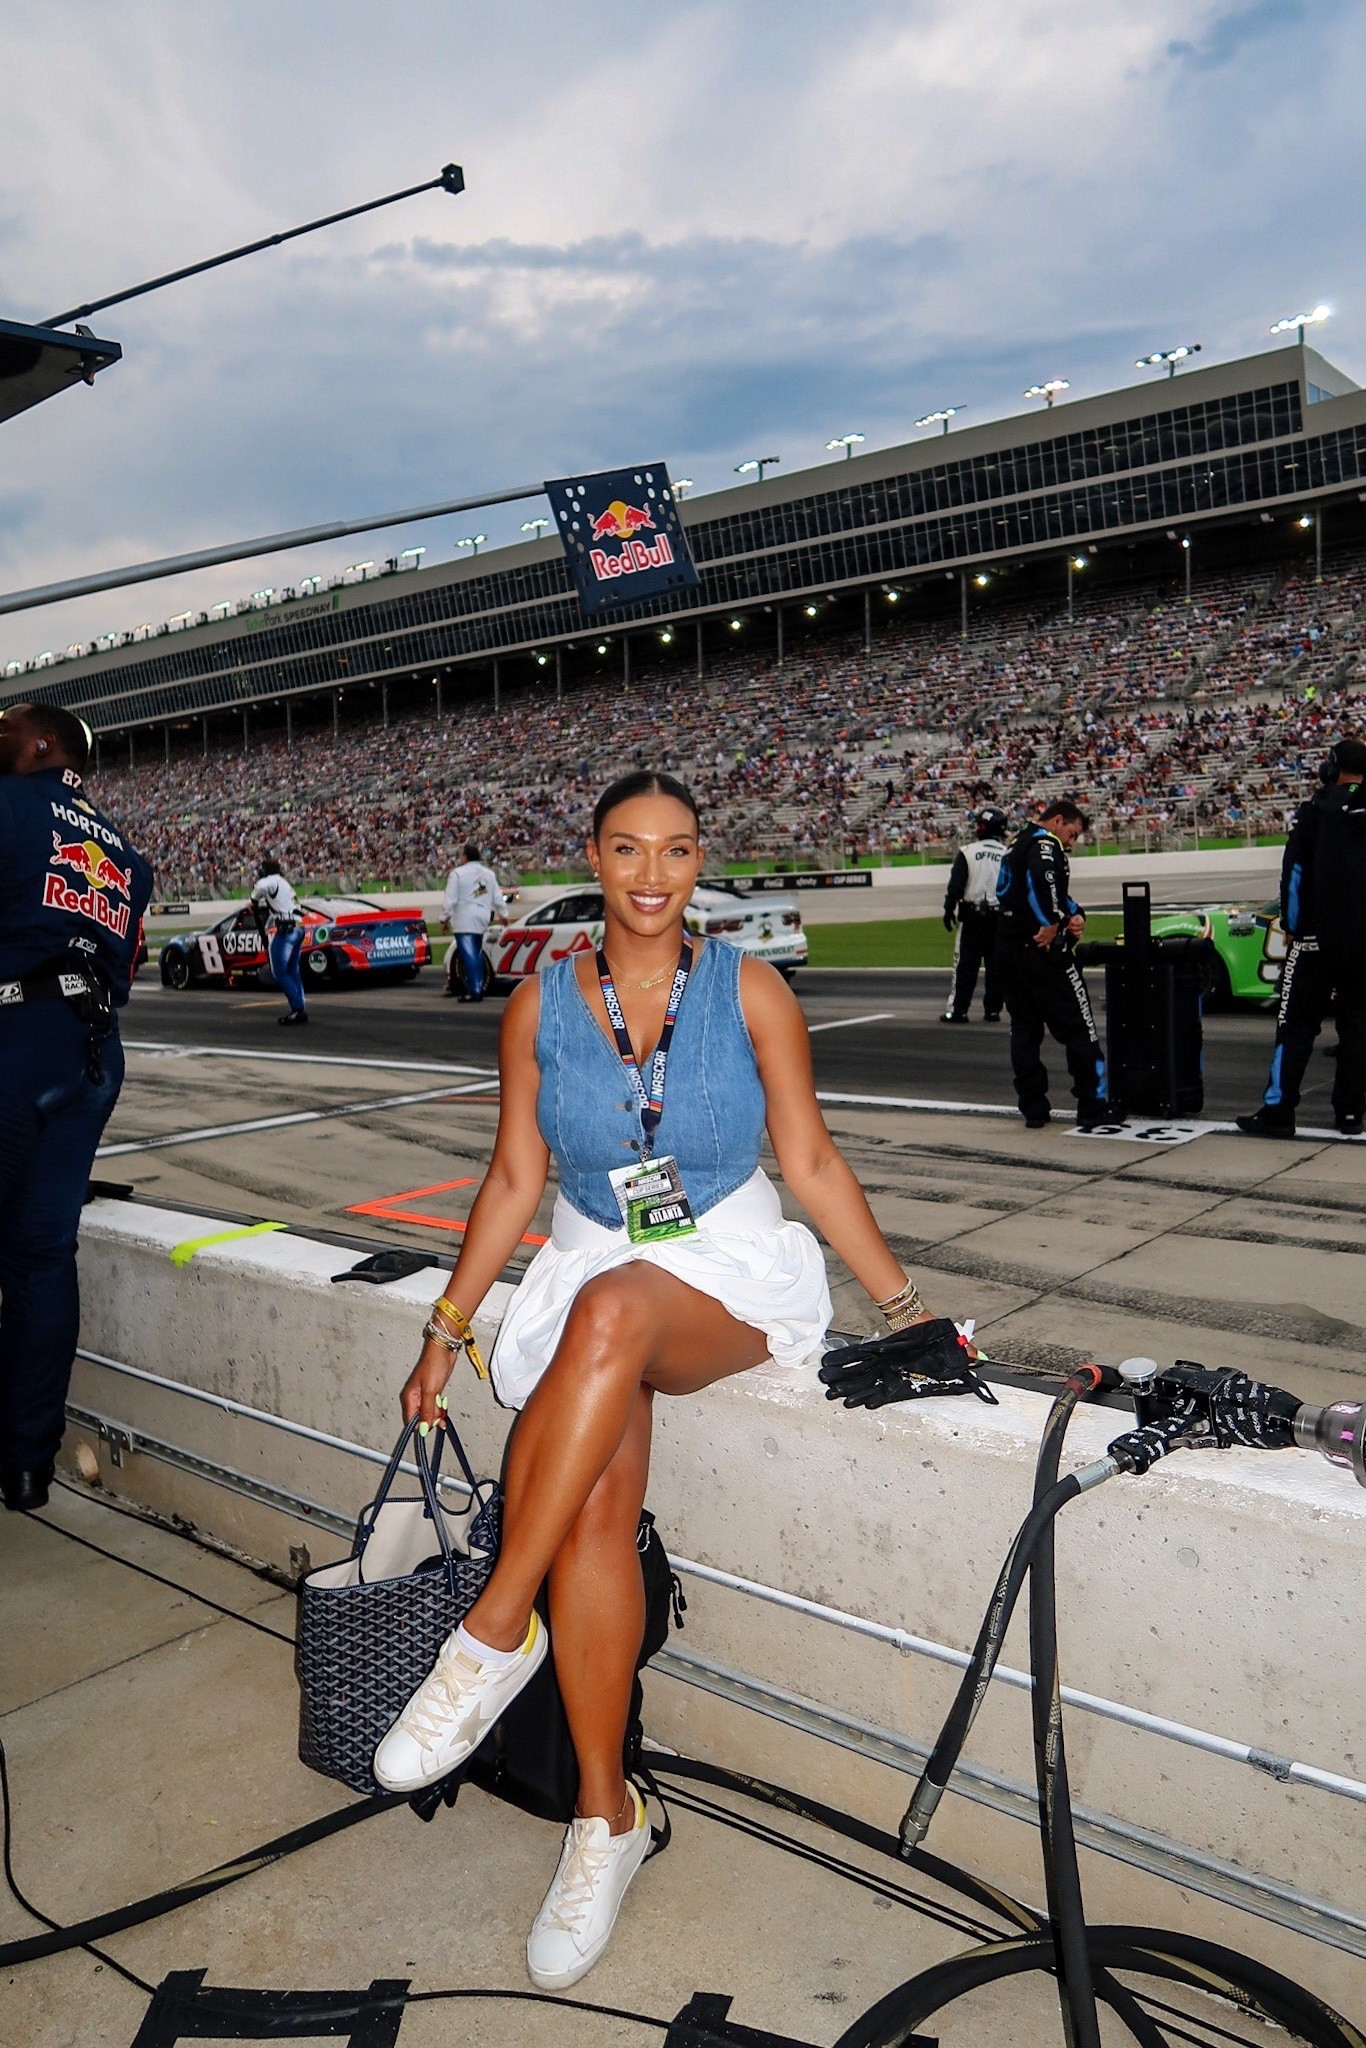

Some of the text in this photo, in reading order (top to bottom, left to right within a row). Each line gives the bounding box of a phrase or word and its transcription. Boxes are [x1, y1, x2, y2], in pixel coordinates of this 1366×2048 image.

[589, 533, 674, 581] Red Bull
[284, 602, 330, 622] SPEEDWAY
[61, 768, 82, 788] 87
[50, 801, 124, 852] HORTON
[975, 851, 1001, 863] OFFIC
[847, 874, 867, 884] SERIES
[42, 872, 131, 939] Red Bull
[197, 934, 225, 974] 8
[237, 933, 265, 953] SEN
[367, 947, 415, 960] CHEVROLET
[497, 928, 553, 975] 77
[747, 945, 795, 958] CHEVROLET
[602, 988, 626, 1030] NASCAR
[668, 968, 689, 1012] NASCAR
[1066, 962, 1098, 1043] TRACKHOUSE
[650, 1050, 668, 1097] NASCAR
[648, 1205, 685, 1225] ATLANTA
